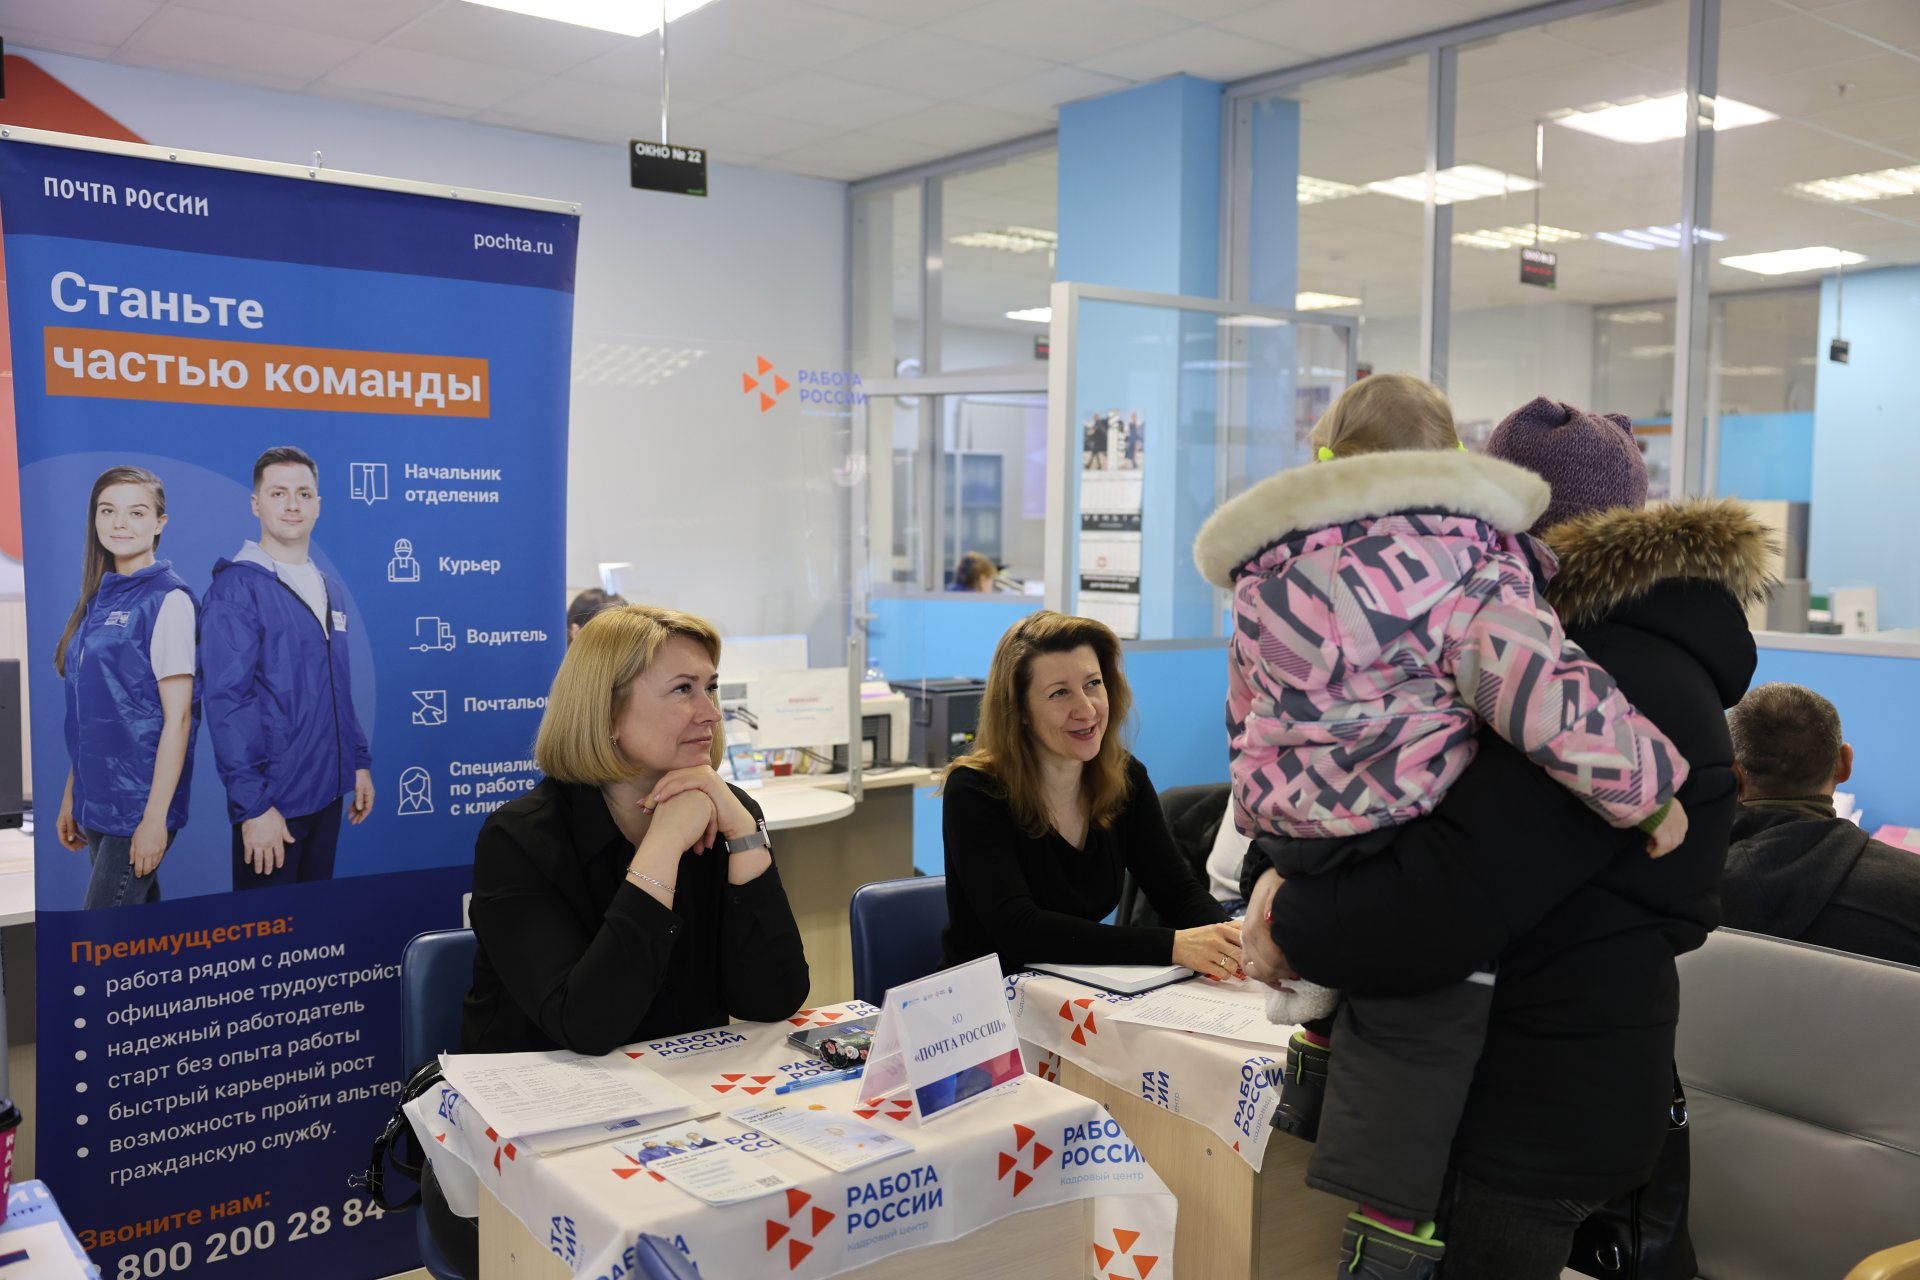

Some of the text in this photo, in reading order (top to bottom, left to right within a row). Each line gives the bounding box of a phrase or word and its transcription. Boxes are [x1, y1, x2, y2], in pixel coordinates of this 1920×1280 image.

[635, 143, 670, 158] ОКНО
[43, 176, 209, 217] ПОЧТА РОССИИ
[474, 232, 554, 255] pochta.ru
[50, 270, 265, 330] Станьте
[53, 345, 482, 408] частью команды
[798, 370, 863, 387] РАБОТА
[800, 389, 868, 406] РОССИИ
[404, 464, 502, 481] Начальник
[405, 488, 499, 505] отделения
[439, 557, 501, 575] Курьер
[467, 629, 547, 645] Водитель
[449, 760, 541, 777] Специалис
[450, 777, 535, 798] по работе
[450, 799, 510, 816] с клие
[71, 916, 294, 965] Преимущества:
[106, 943, 345, 997] работа рядом с домом
[107, 962, 402, 1026] официальное трудоустройст
[108, 1000, 365, 1057] надежный работодатель
[952, 1013, 963, 1025] АО
[649, 1030, 734, 1050] РАБОТА
[658, 1035, 747, 1056] РОССИИ
[914, 1019, 1006, 1062] «ПОЧТА РОССИИ»
[108, 1029, 360, 1089] старт без опыта работы
[108, 1056, 375, 1121] быстрый карьерный рост
[1233, 1056, 1276, 1127] РАБОТА
[110, 1081, 402, 1153] возможность пройти альтер
[1064, 1119, 1121, 1146] РАБО
[110, 1120, 336, 1187] гражданскую службу.
[847, 1164, 938, 1207] РАБОТА
[1060, 1172, 1144, 1185] Кадровый центр
[79, 1191, 271, 1251] Звоните нам:
[847, 1188, 943, 1234] РОССИИ
[116, 1198, 386, 1280] 800 200 28 84
[847, 1220, 929, 1251] Кадровый центр
